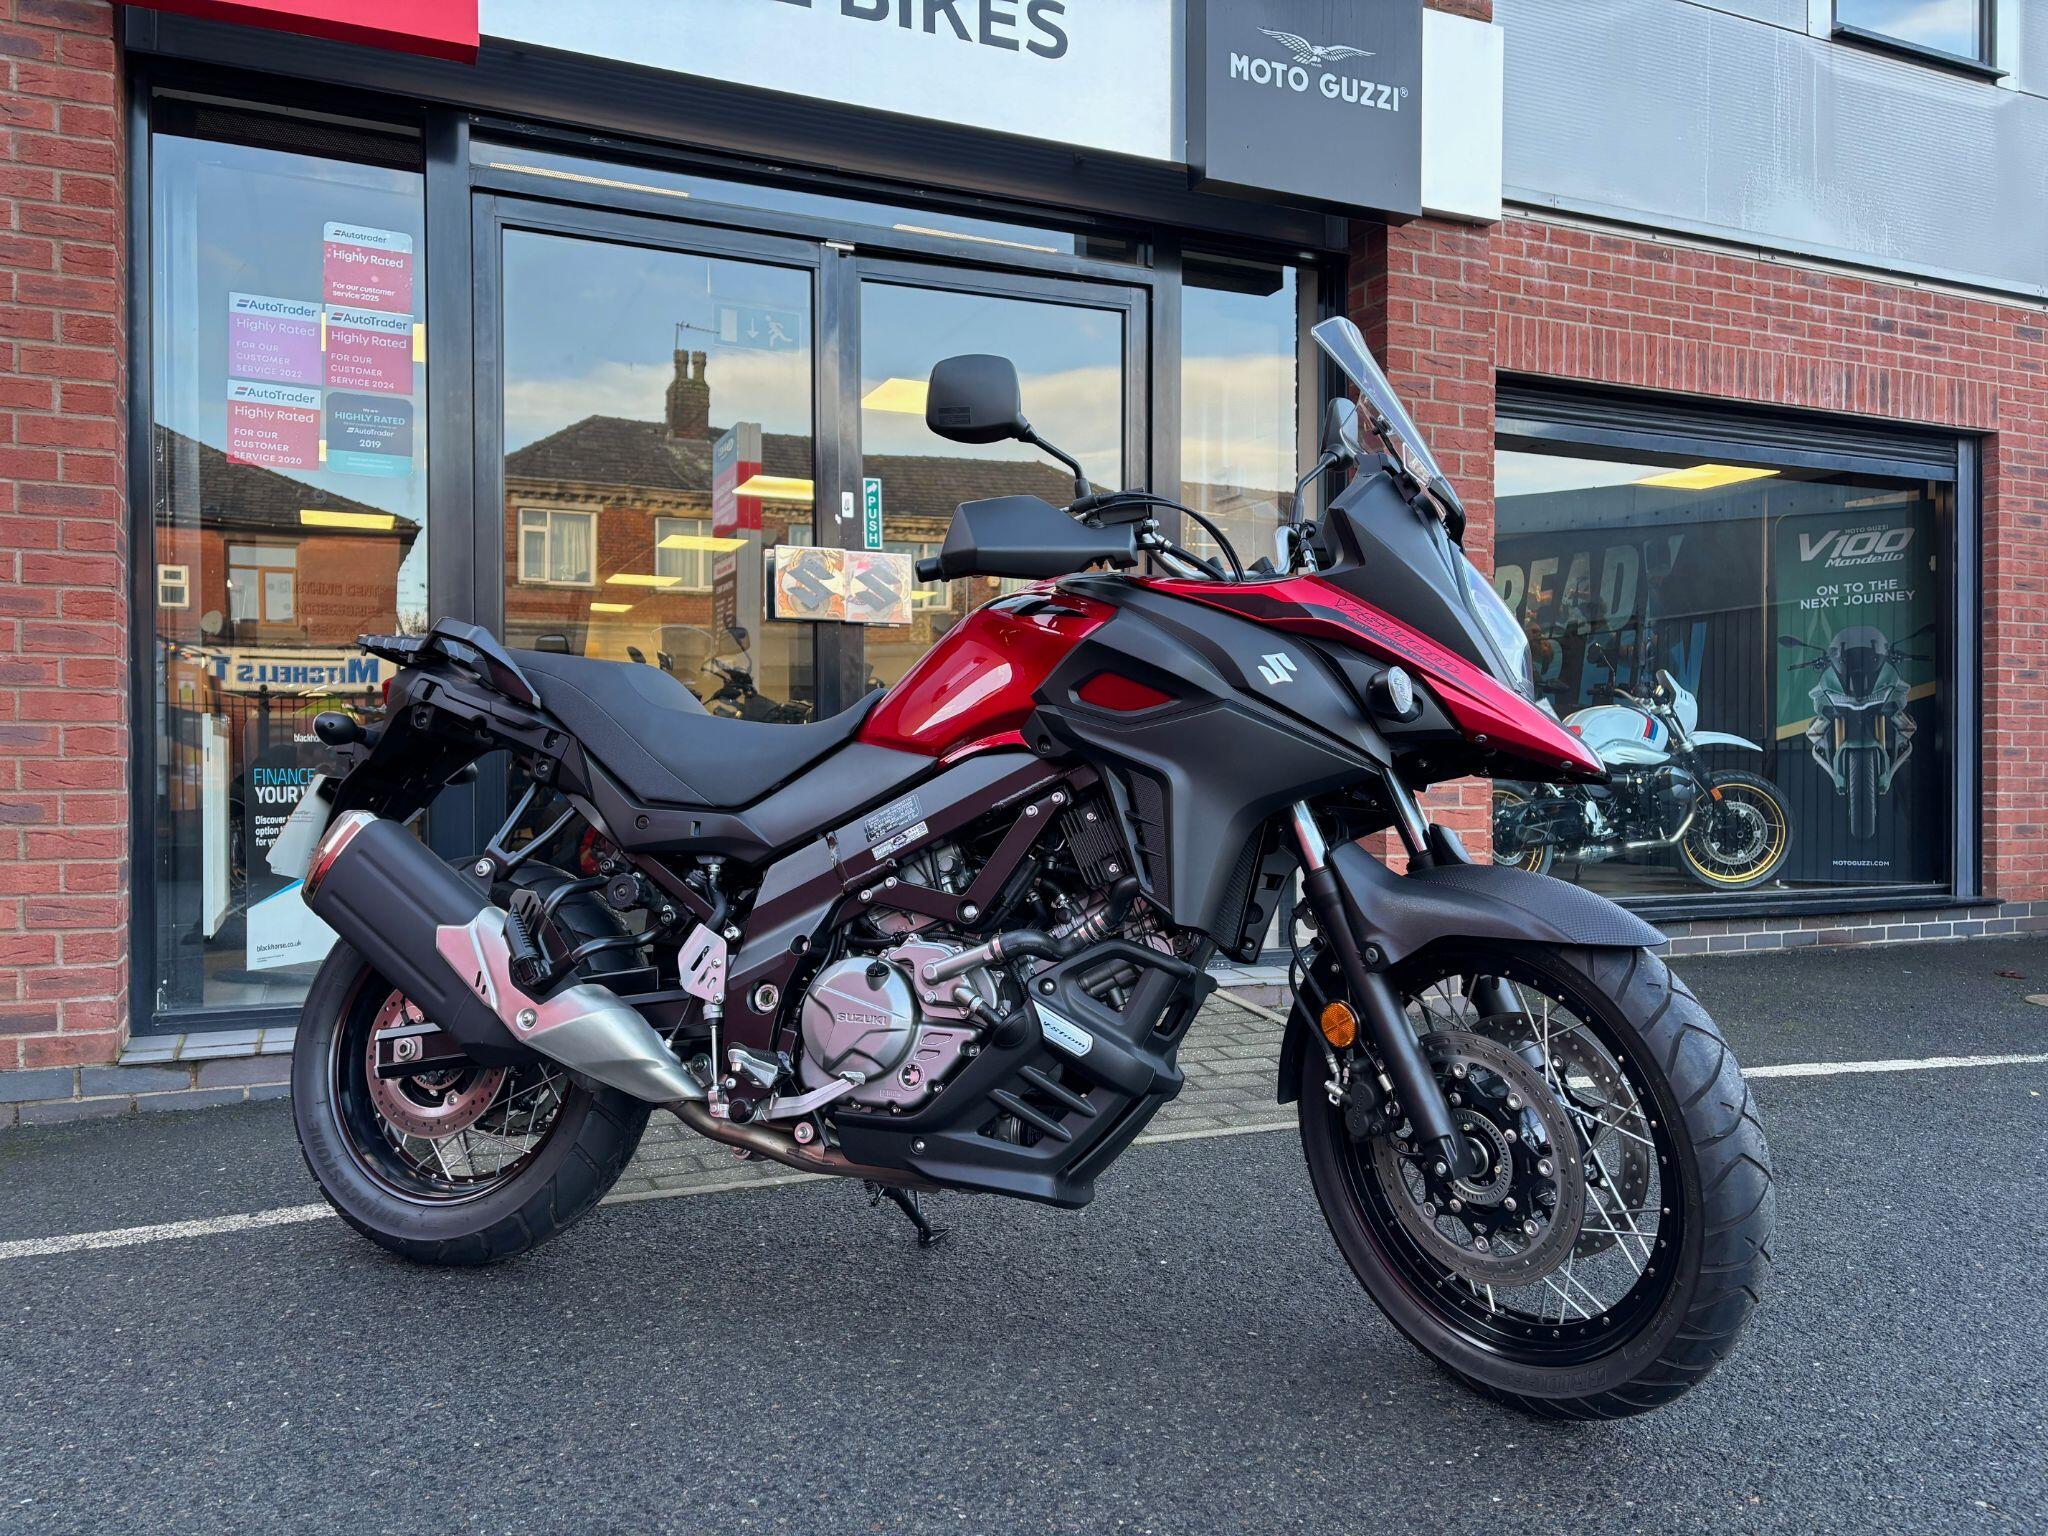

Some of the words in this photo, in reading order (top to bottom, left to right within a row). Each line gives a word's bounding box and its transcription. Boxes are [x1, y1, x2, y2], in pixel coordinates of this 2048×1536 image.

[1230, 52, 1309, 92] MOTO
[333, 249, 368, 265] Highly
[370, 255, 404, 268] Rated
[332, 281, 345, 289] For
[346, 283, 359, 291] our
[359, 285, 396, 297] customer
[332, 290, 360, 300] service
[361, 294, 379, 302] 2025
[249, 300, 316, 317] AutoTrader
[236, 318, 276, 334] Highly
[280, 323, 316, 337] Rated
[343, 313, 408, 330] AutoTrader
[236, 340, 255, 349] FOR
[258, 343, 280, 353] OUR
[331, 331, 369, 346] Highly
[371, 336, 407, 349] Rated
[236, 353, 291, 365] CUSTOMER
[330, 353, 349, 362] FOR
[352, 355, 372, 364] OUR
[236, 364, 277, 375] SERVICE
[279, 369, 303, 378] 2022
[330, 364, 383, 377] CUSTOMER
[330, 376, 370, 387] SERVICE
[371, 381, 395, 389] 2024
[247, 388, 315, 404] AutoTrader
[234, 405, 275, 421] Highly
[277, 410, 314, 423] Rated
[334, 411, 373, 422] HIGHLY
[374, 415, 406, 425] RATED
[233, 428, 254, 437] FOR
[256, 430, 278, 439] OUR
[354, 428, 394, 438] AutoTrader
[233, 440, 289, 452] CUSTOMER
[359, 439, 382, 448] 2019
[233, 451, 276, 462] SERVICE
[278, 456, 302, 465] 2020
[868, 496, 878, 544] PUSH
[1798, 527, 1916, 562] V100
[1824, 552, 1905, 568] Mandello
[1816, 584, 1839, 596] ON
[1844, 582, 1864, 593] TO
[1868, 579, 1898, 591] THE
[1800, 597, 1839, 610] NEXT
[1843, 590, 1916, 606] JOURNEY
[254, 786, 298, 804] YOUR
[255, 815, 286, 825] Discover
[254, 826, 279, 837] option
[255, 838, 268, 847] for
[256, 939, 302, 953] blackhorse.co.uk
[835, 1012, 887, 1026] SUZUKI
